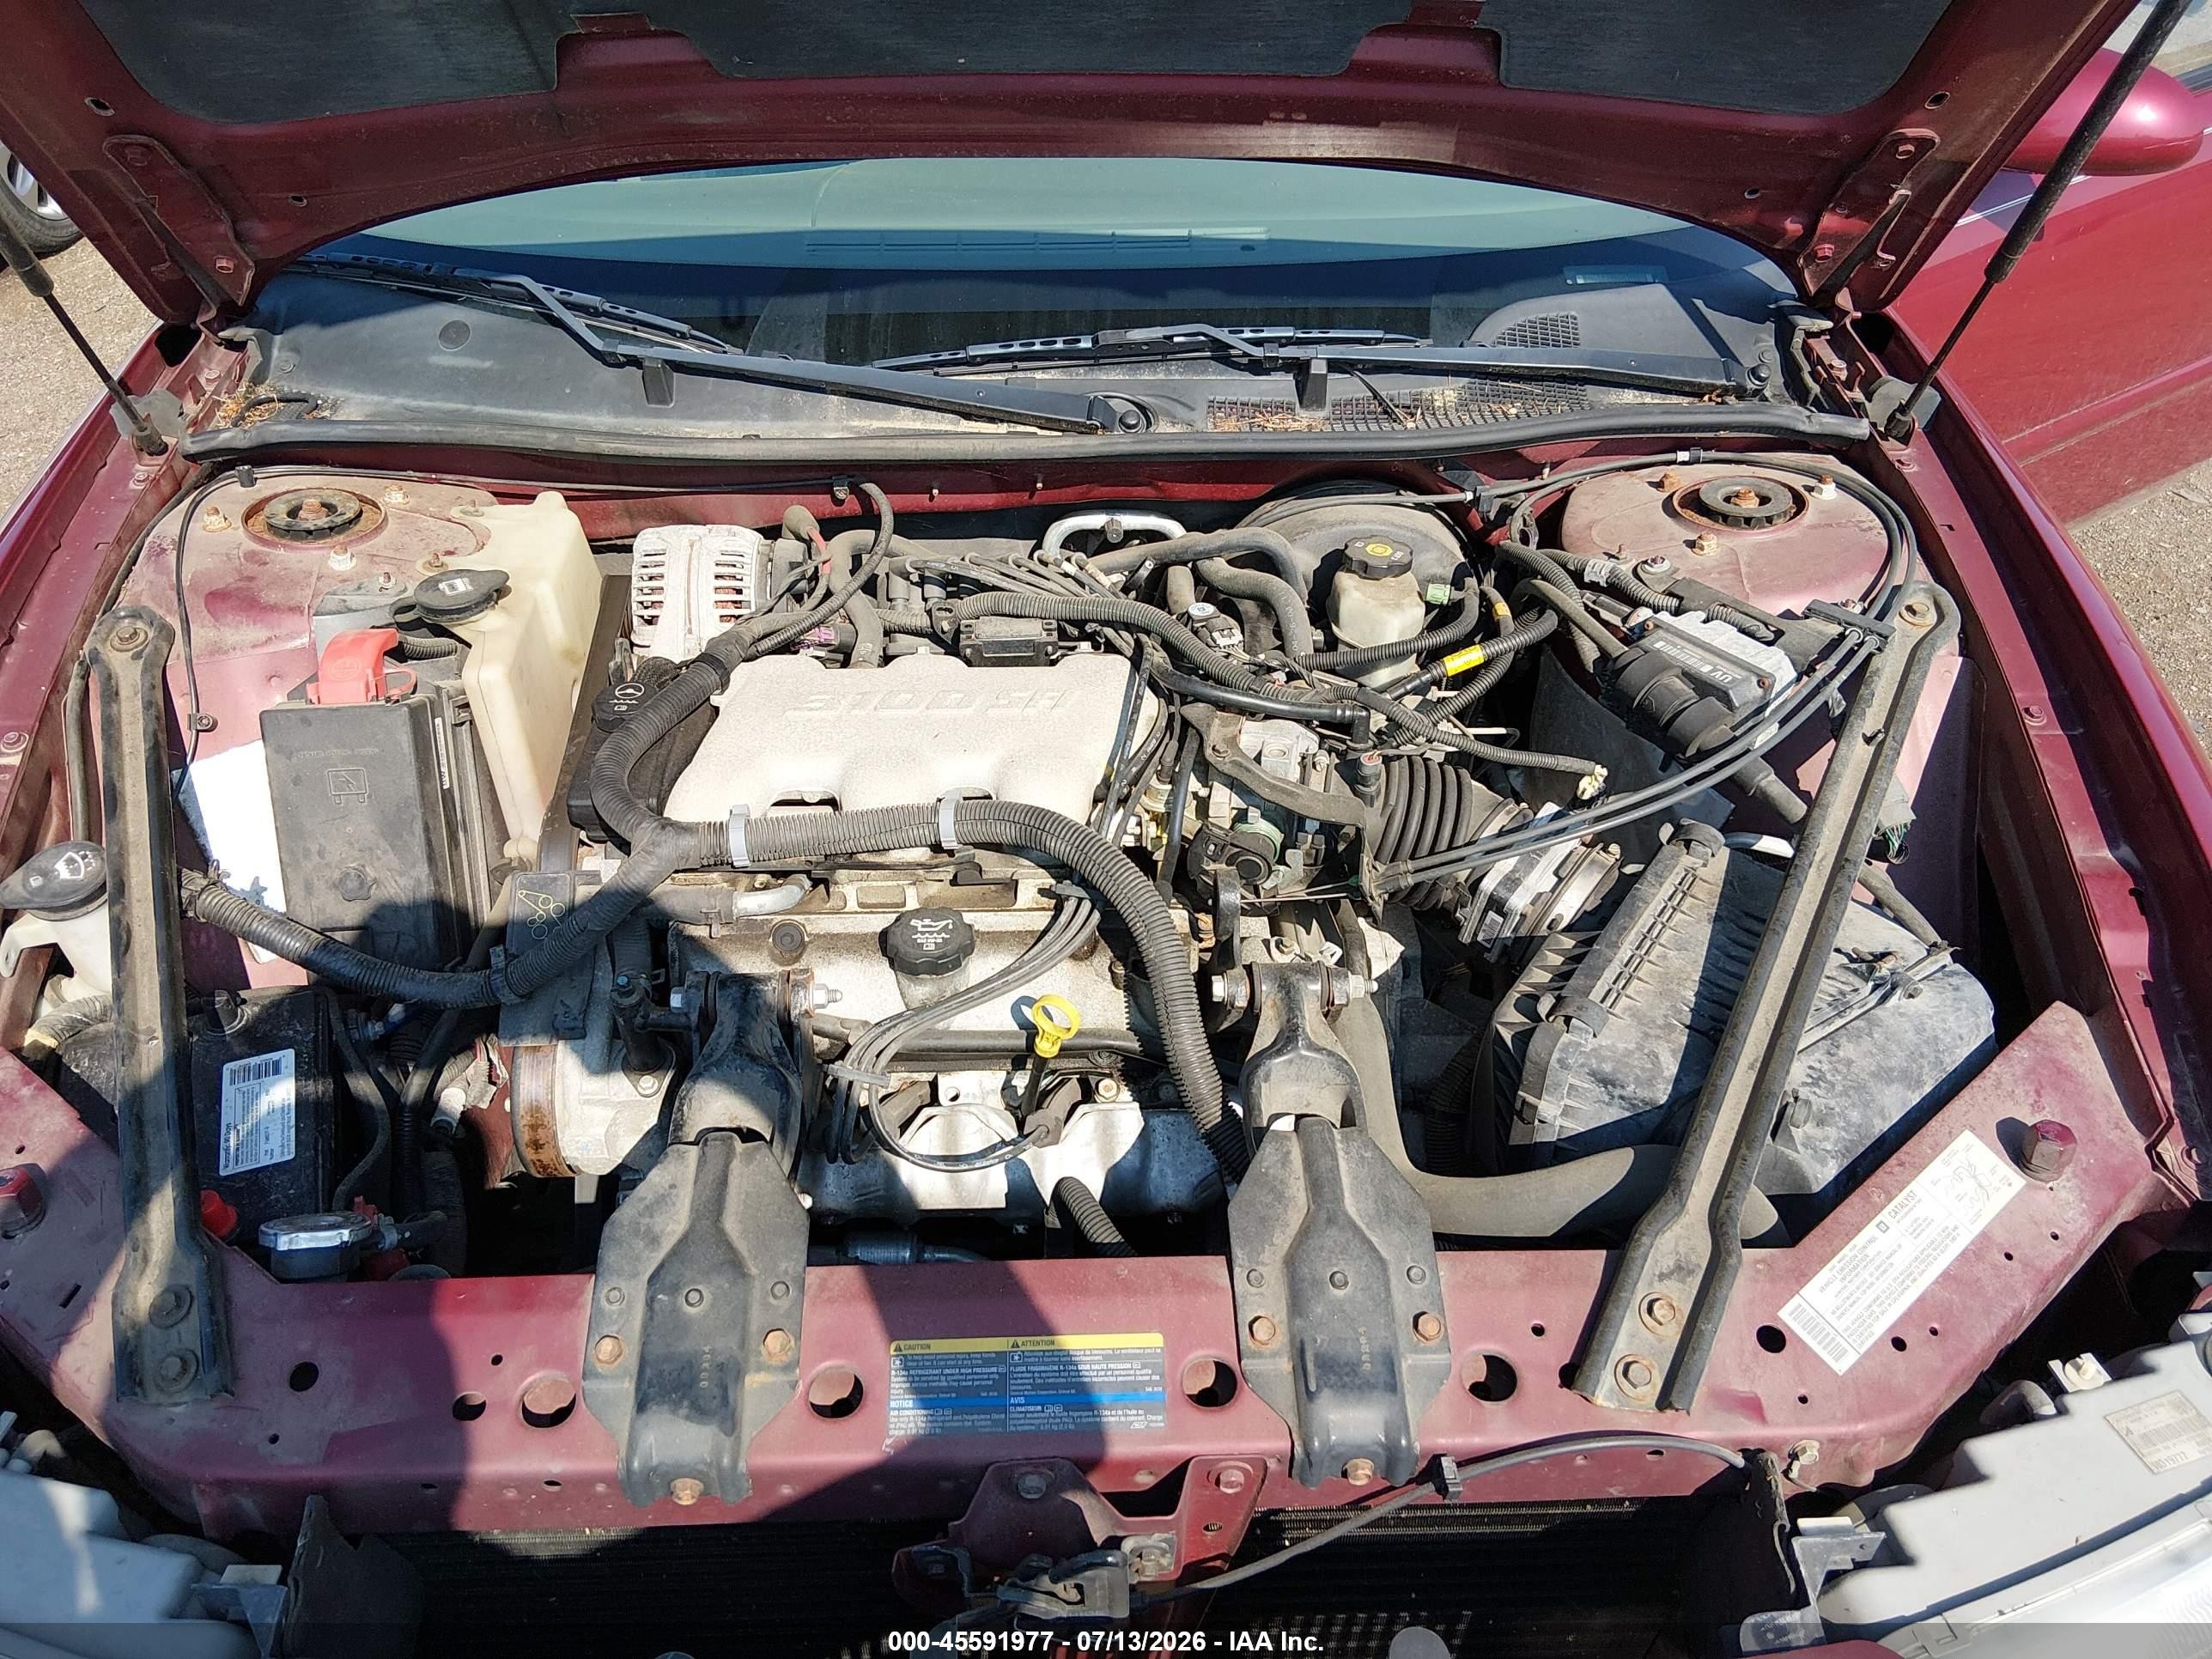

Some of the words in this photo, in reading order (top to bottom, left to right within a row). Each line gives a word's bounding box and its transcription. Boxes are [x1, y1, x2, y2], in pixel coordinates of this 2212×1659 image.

[784, 687, 975, 715] 3100
[1887, 1189, 1918, 1220] CATALYST
[1817, 1273, 1838, 1293] VEHICLE
[1835, 1252, 1859, 1276] EMISSION
[1856, 1233, 1878, 1255] CONTROL
[1838, 1252, 1869, 1283] INFORMATION
